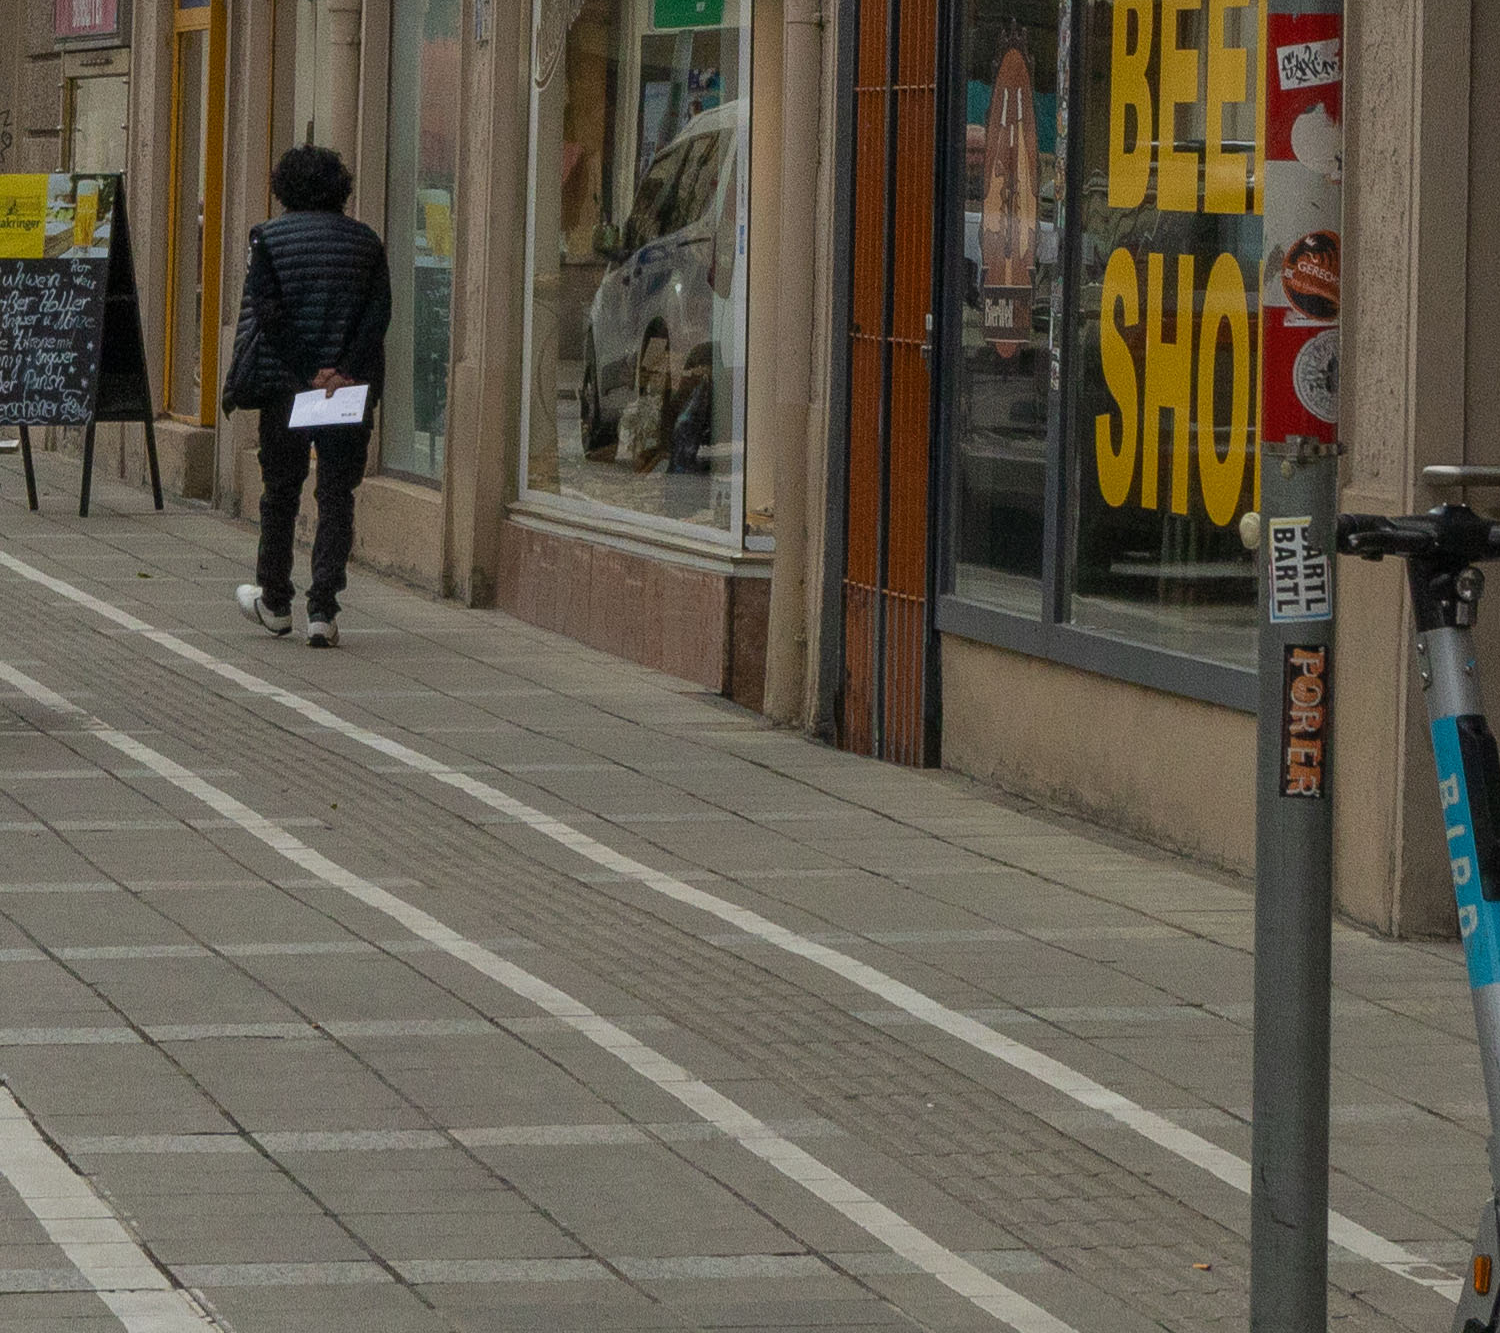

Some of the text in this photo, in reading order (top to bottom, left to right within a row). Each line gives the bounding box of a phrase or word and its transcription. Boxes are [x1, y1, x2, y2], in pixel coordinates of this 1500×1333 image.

[39, 289, 91, 313] Holler
[1096, 247, 1263, 526] SHO
[1273, 527, 1300, 614] BARTL
[1437, 773, 1480, 939] BIRD
